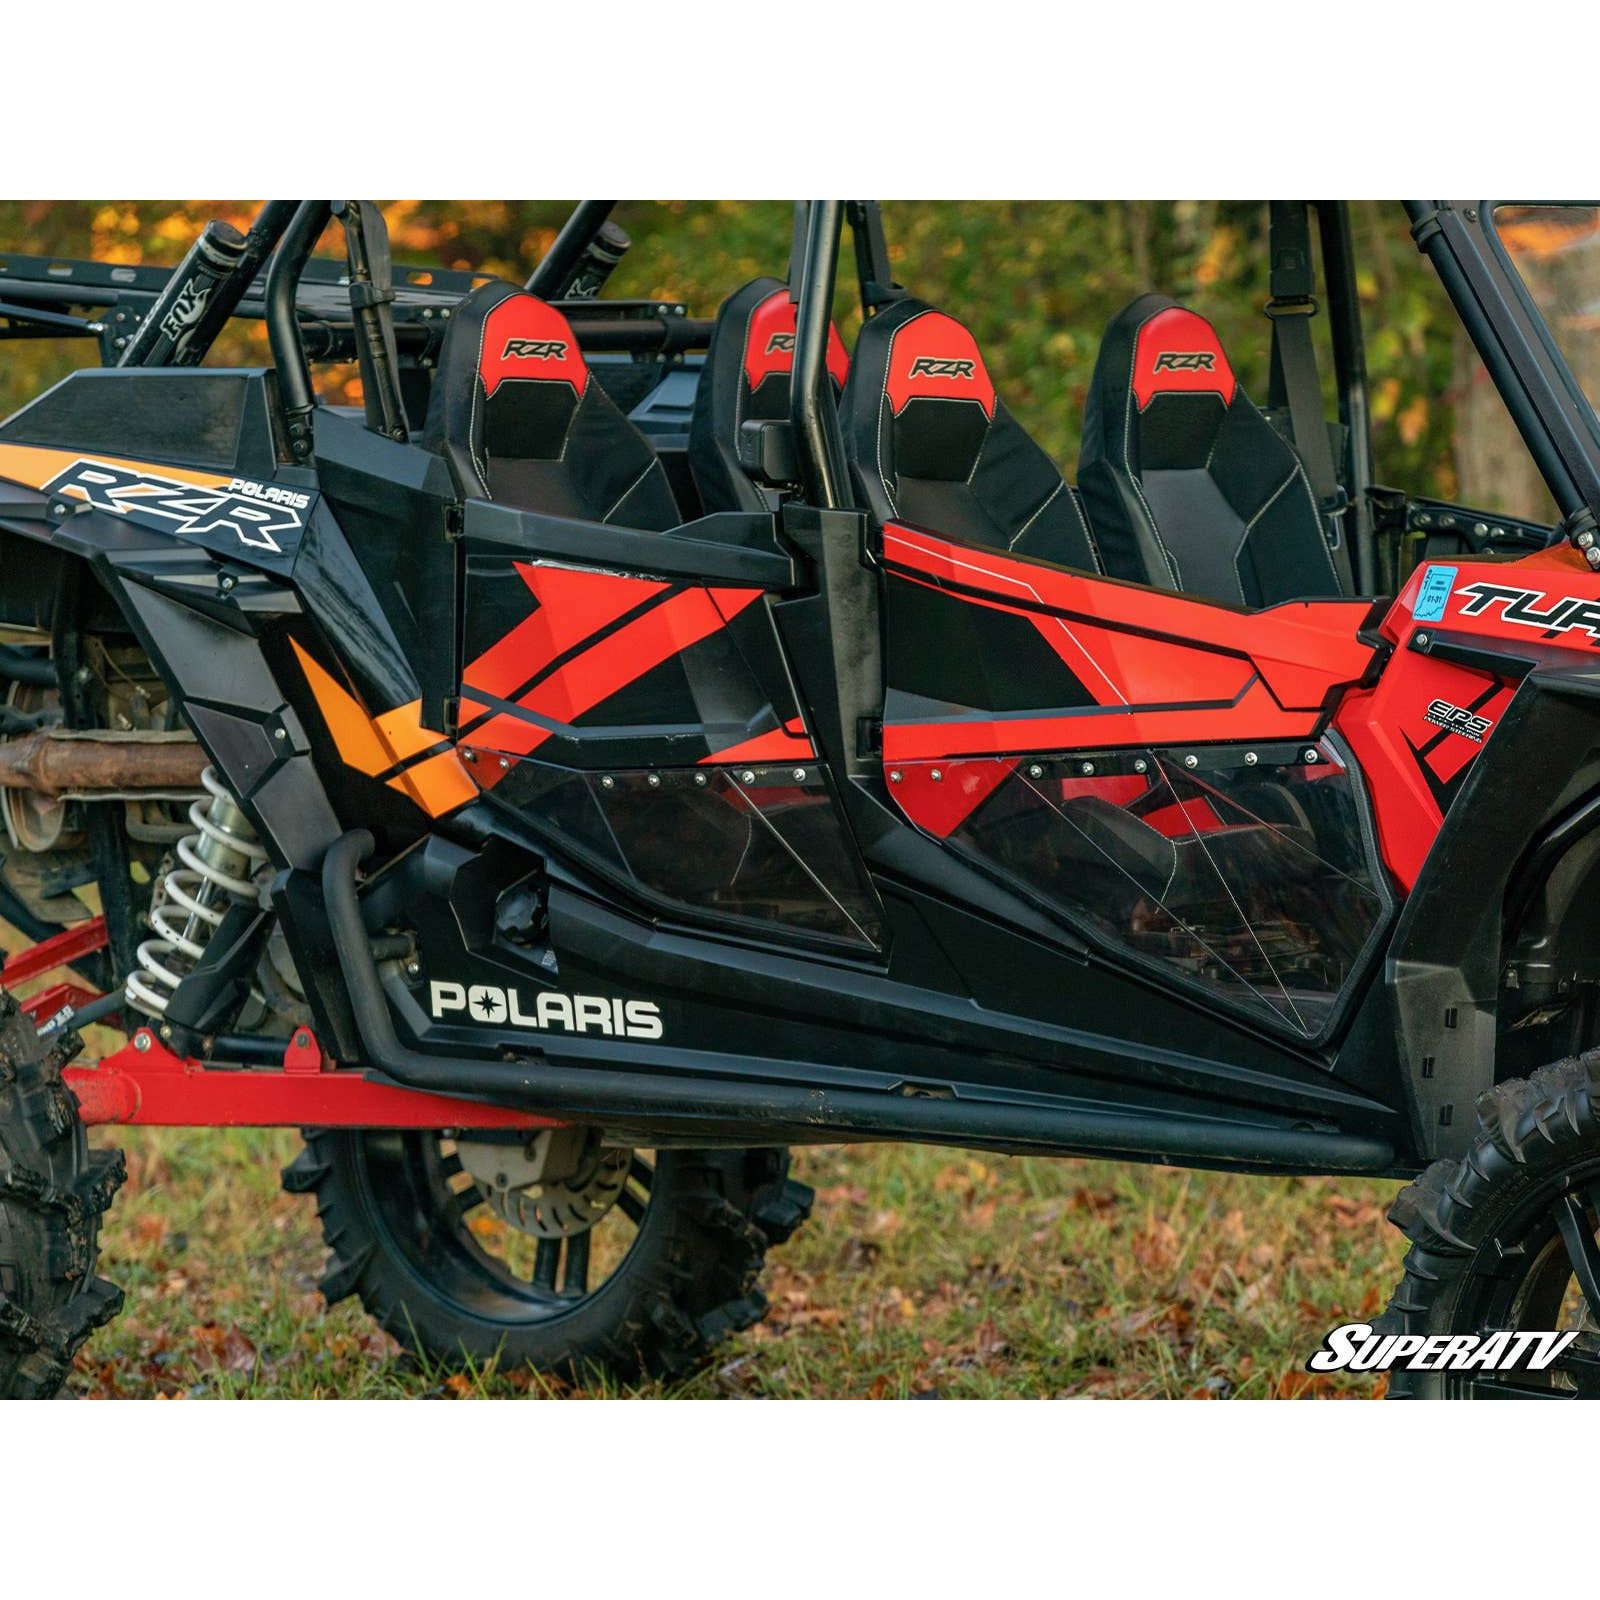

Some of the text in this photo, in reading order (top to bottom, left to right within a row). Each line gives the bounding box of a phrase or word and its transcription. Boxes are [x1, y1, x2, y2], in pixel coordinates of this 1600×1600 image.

[160, 278, 204, 341] FOX
[500, 338, 568, 361] RZR
[1152, 351, 1217, 374] RZR
[908, 356, 975, 381] RZR
[38, 458, 302, 553] RZR
[228, 478, 311, 509] POLARIS
[1427, 698, 1494, 734] EPS
[430, 980, 664, 1040] POLARIS
